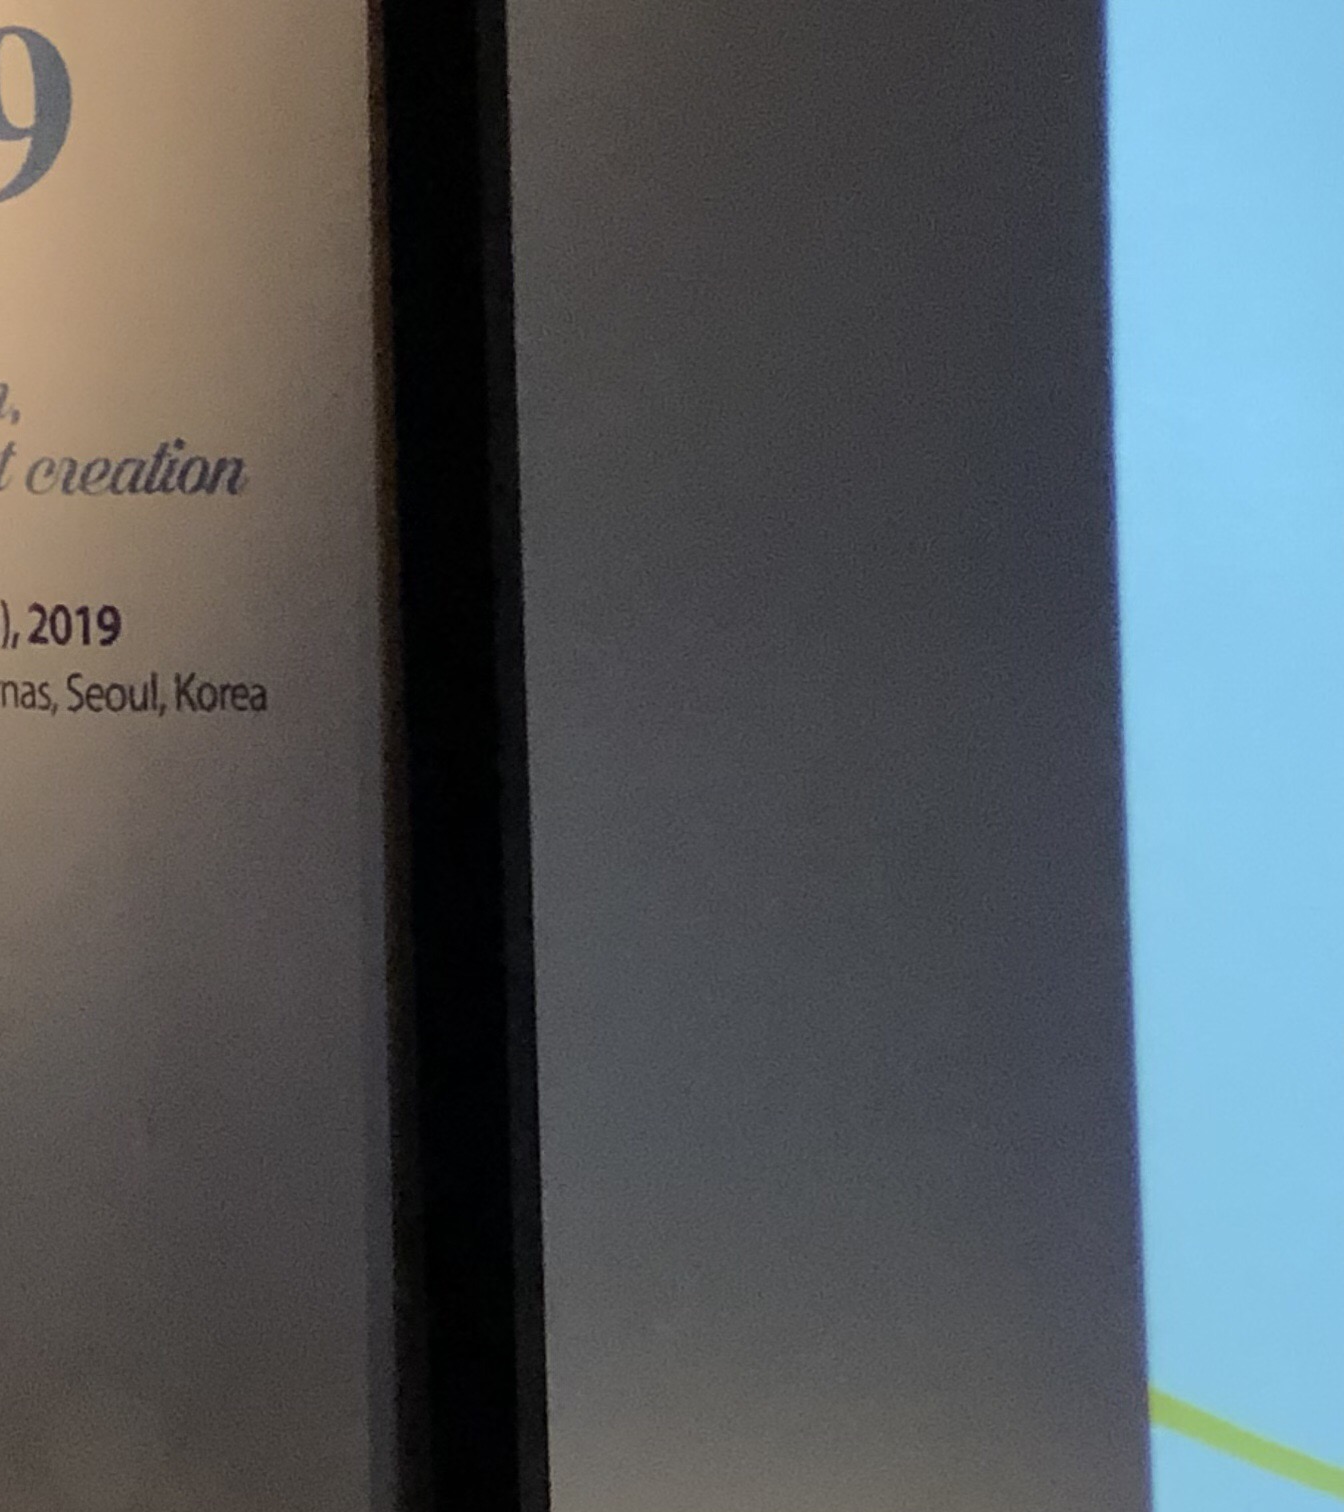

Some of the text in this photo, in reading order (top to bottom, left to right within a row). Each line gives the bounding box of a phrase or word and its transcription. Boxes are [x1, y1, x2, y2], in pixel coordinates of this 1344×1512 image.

[25, 437, 249, 496] creation
[27, 602, 122, 647] 2019
[66, 671, 167, 718] Seoul,
[174, 671, 268, 713] Korea
